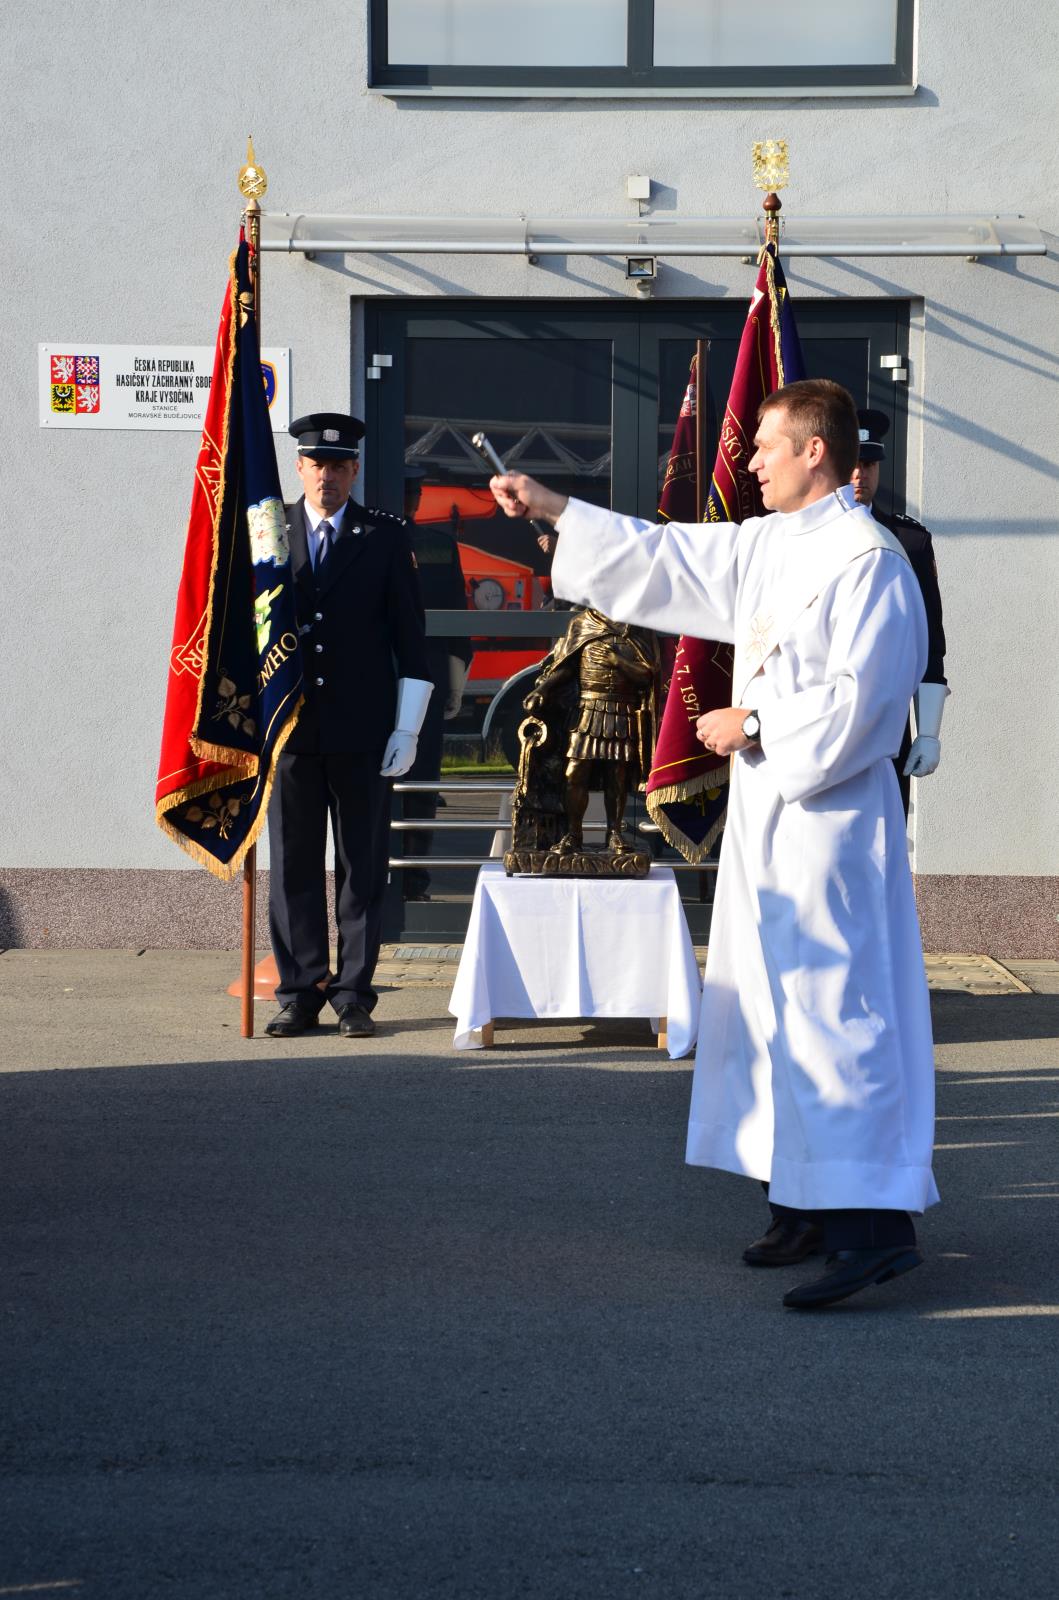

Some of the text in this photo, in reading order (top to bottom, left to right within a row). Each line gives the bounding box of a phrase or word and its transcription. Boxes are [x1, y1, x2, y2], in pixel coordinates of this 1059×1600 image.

[134, 357, 195, 373] ČESKÁ REPUBLIKA
[116, 372, 151, 387] HASIČSKÝ
[152, 373, 194, 388] ZÁCHRANNÝ
[135, 389, 194, 403] KRAJE VYSOČINA
